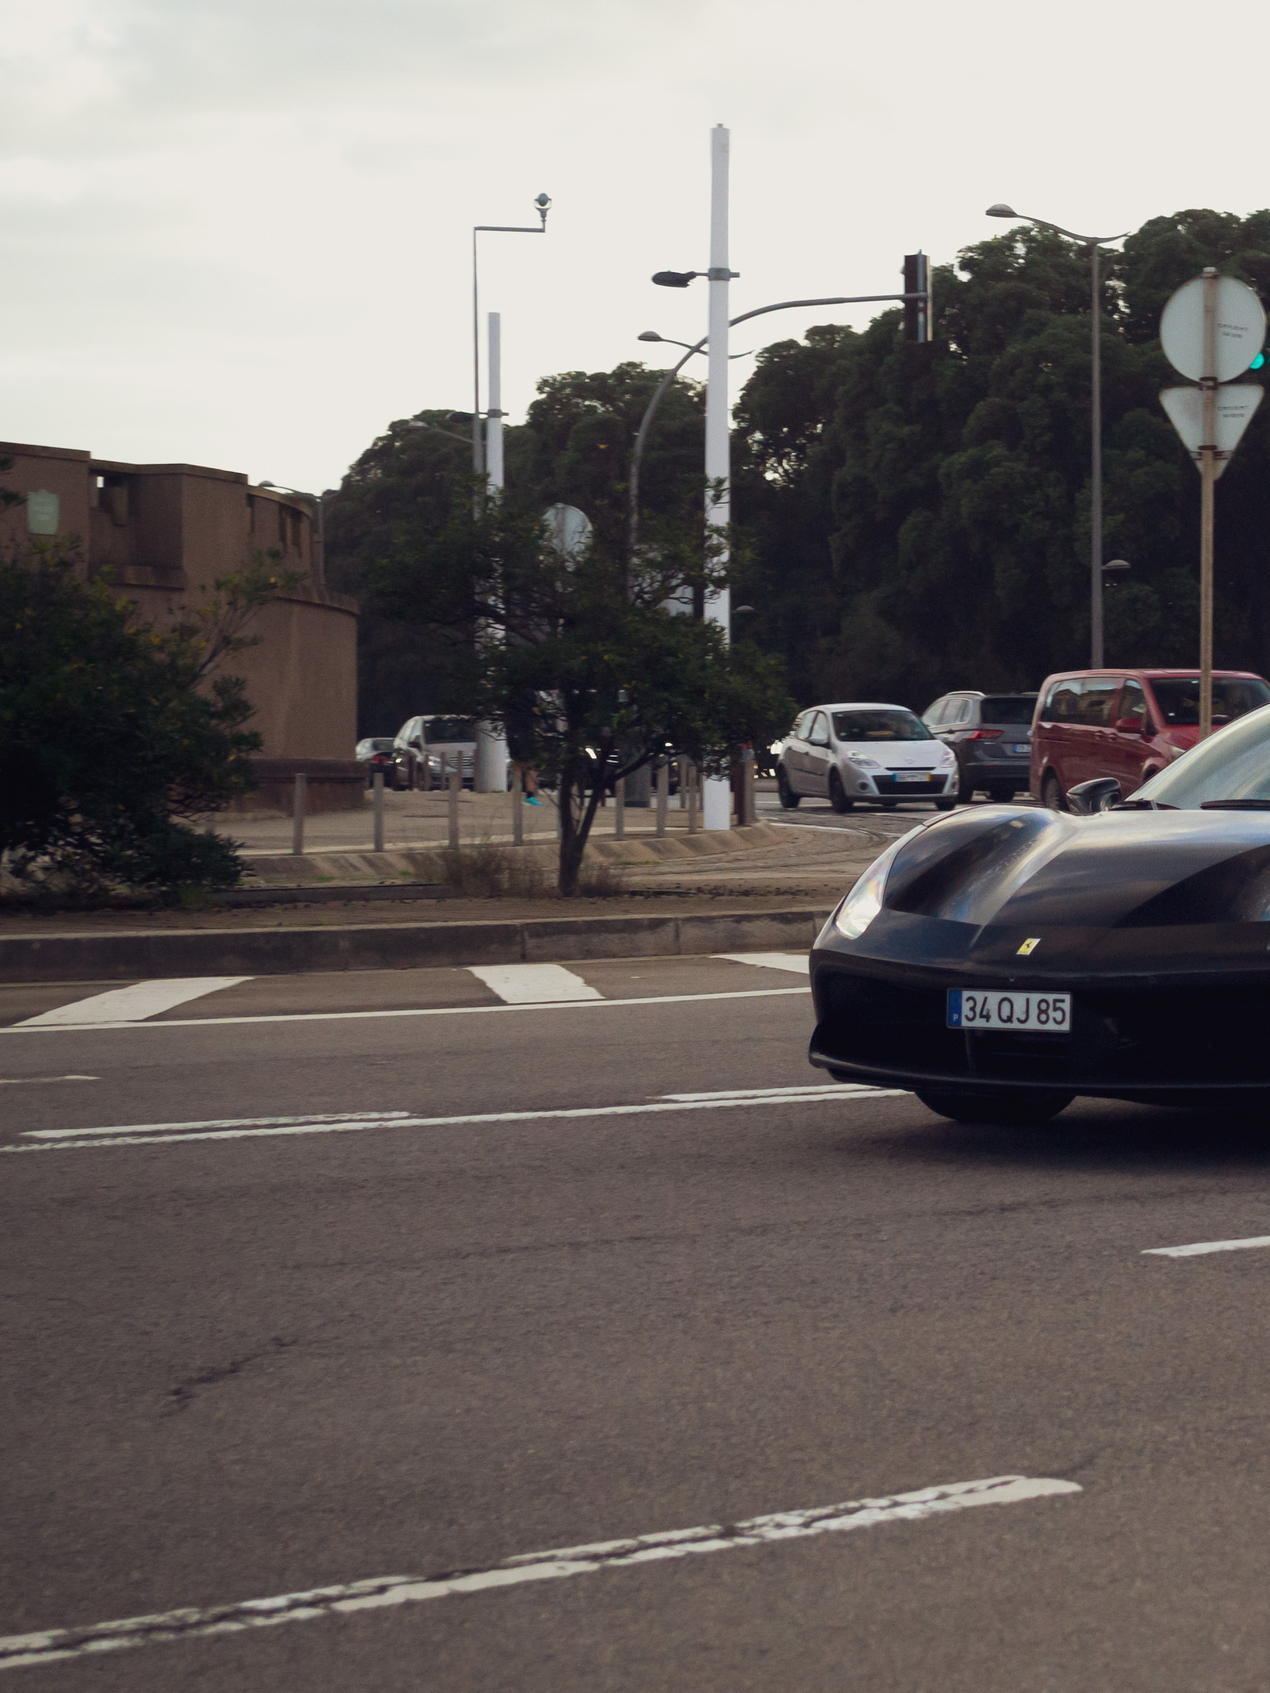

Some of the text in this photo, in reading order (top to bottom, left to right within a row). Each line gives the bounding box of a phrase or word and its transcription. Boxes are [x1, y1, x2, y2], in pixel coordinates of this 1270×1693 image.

[964, 995, 1066, 1025] 34 QJ 85
